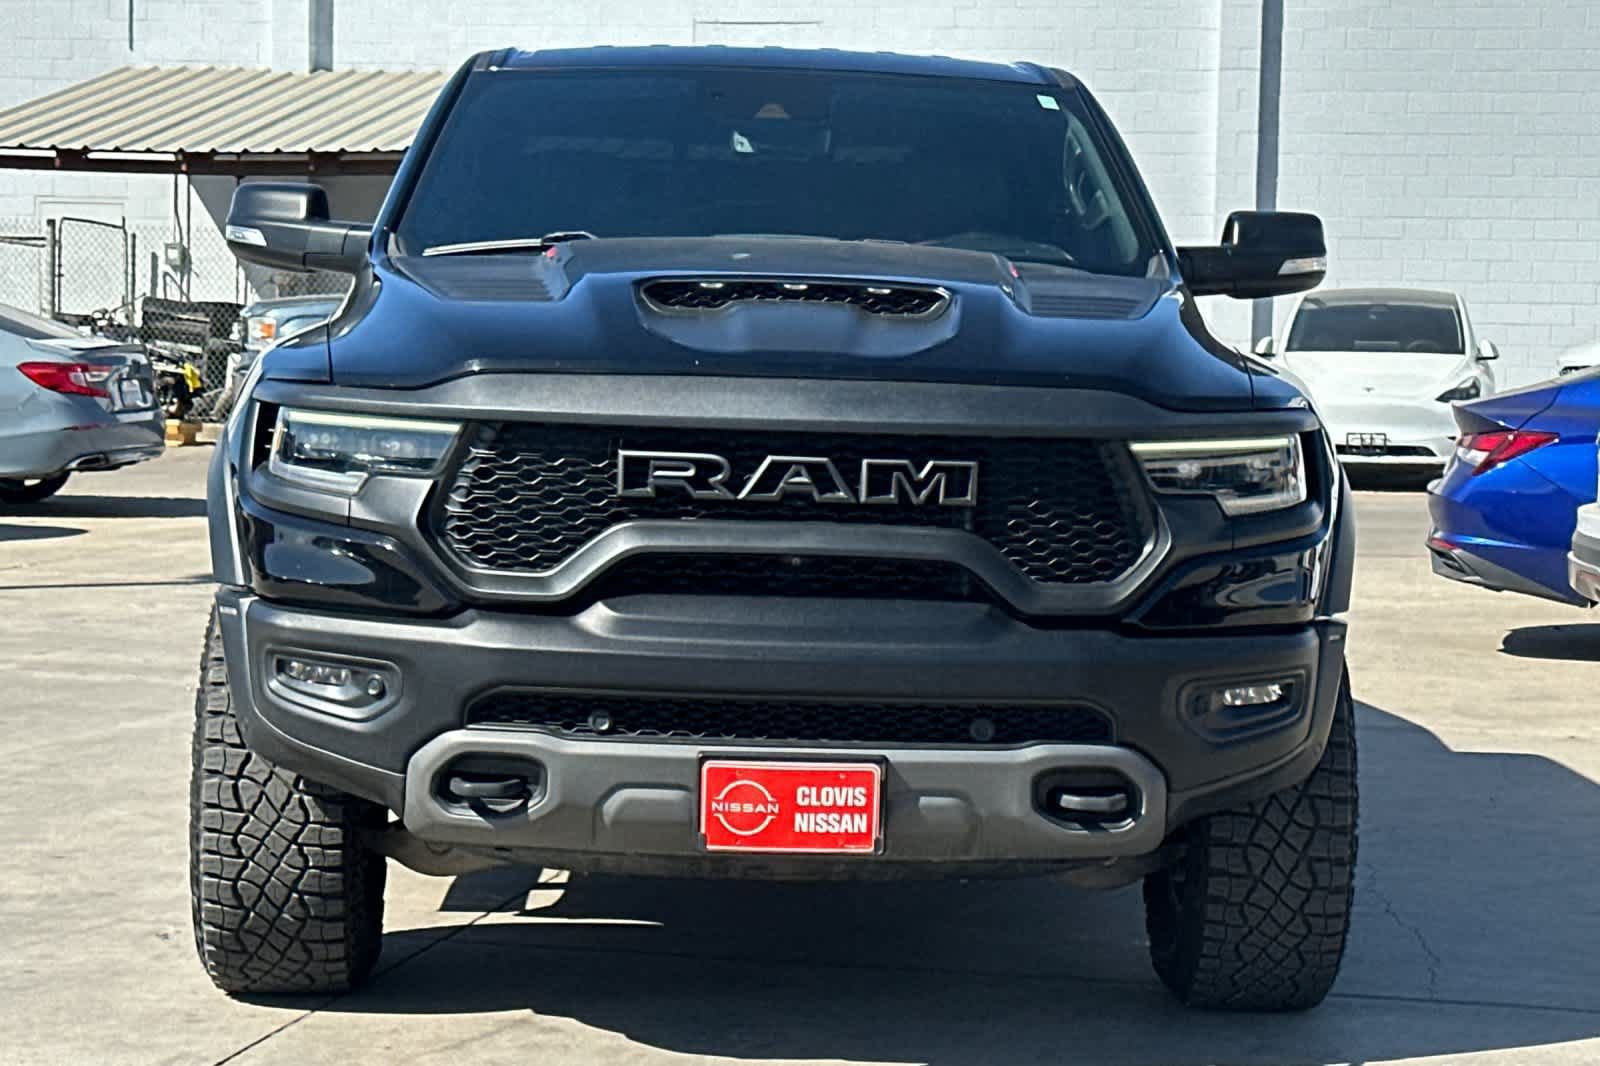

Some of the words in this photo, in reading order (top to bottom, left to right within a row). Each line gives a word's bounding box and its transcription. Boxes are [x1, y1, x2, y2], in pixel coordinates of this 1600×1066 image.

[617, 449, 979, 506] RAM
[796, 786, 867, 807] CLOVIS
[711, 801, 780, 814] NISSAN
[794, 813, 867, 834] NISSAN
